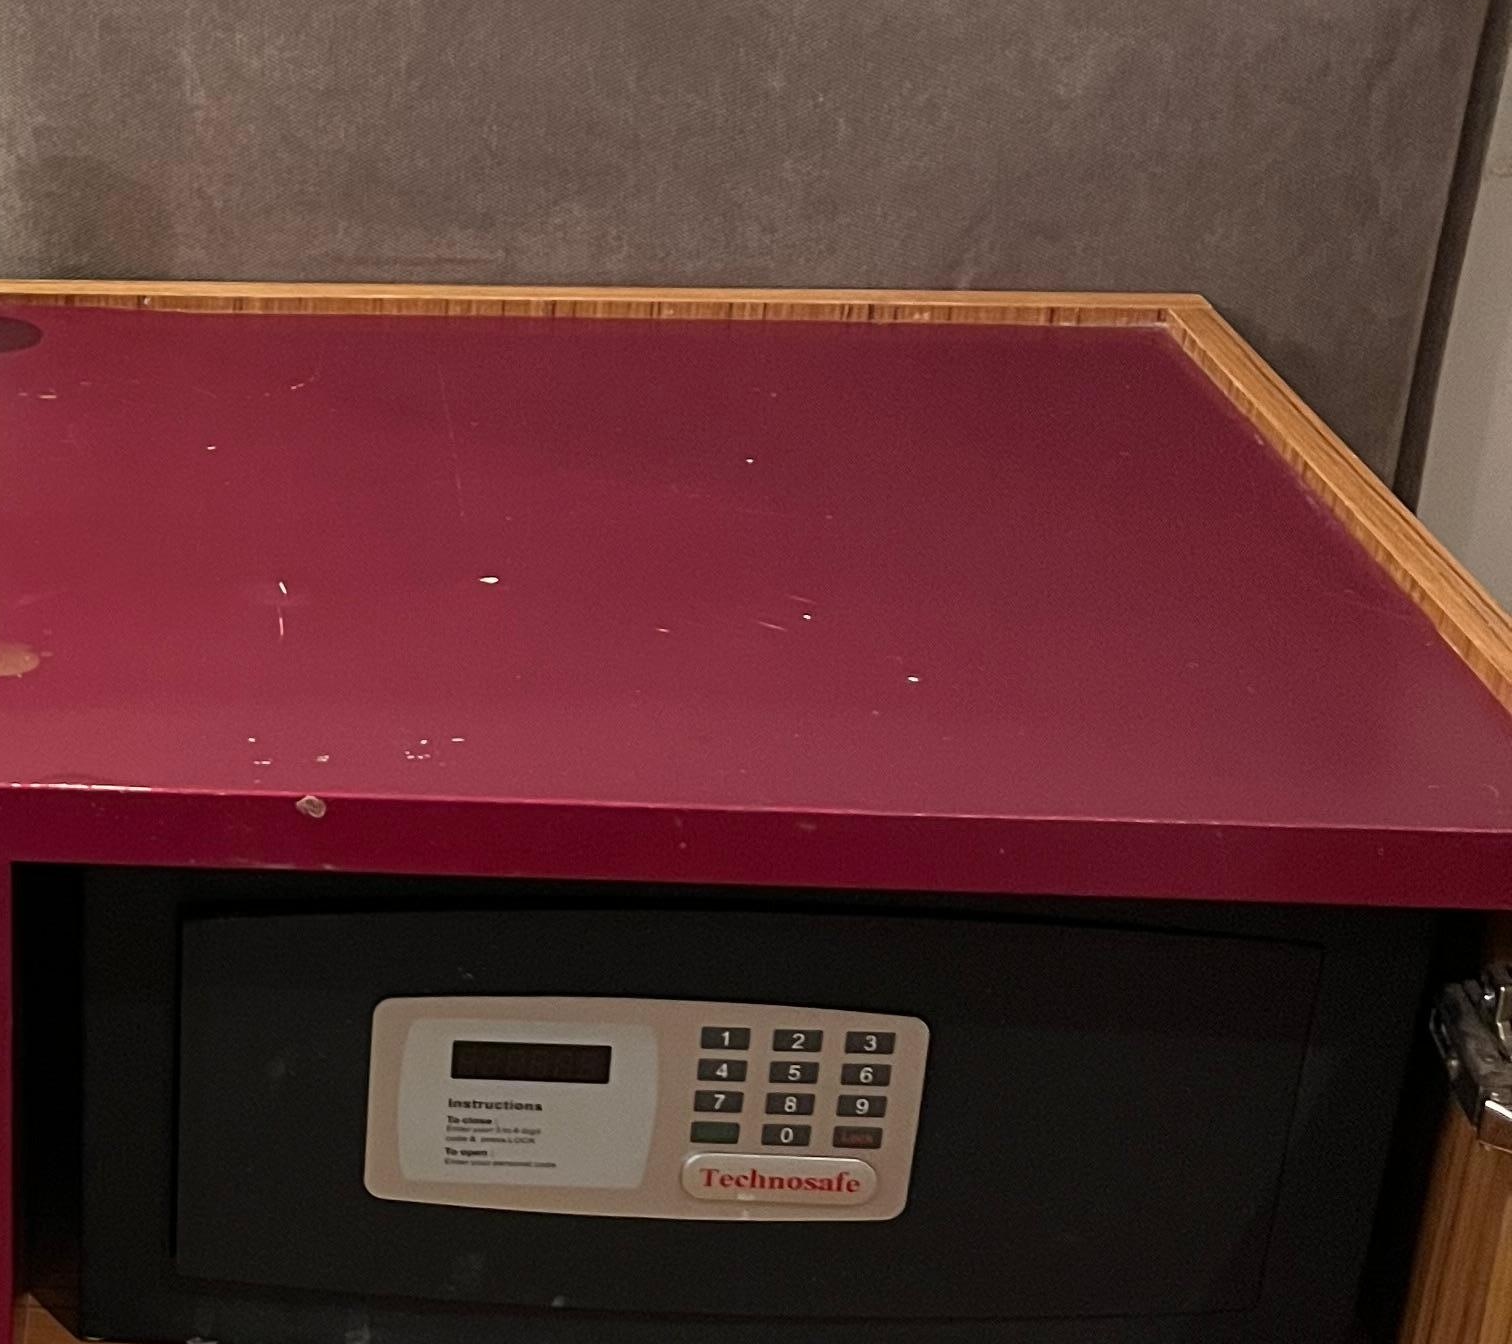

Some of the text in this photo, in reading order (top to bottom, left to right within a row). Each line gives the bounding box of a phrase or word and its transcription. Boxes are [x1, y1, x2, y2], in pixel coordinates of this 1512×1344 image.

[721, 1031, 731, 1047] 1
[791, 1033, 805, 1049] 2
[863, 1035, 877, 1051] 3
[715, 1063, 728, 1079] 4
[788, 1064, 801, 1081] 5
[859, 1066, 874, 1083] 6
[448, 1098, 543, 1111] Instructions
[714, 1094, 726, 1110] 7
[784, 1096, 797, 1113] 8
[855, 1098, 870, 1115] 9
[780, 1127, 794, 1143] 0
[699, 1168, 861, 1193] Technosafe
